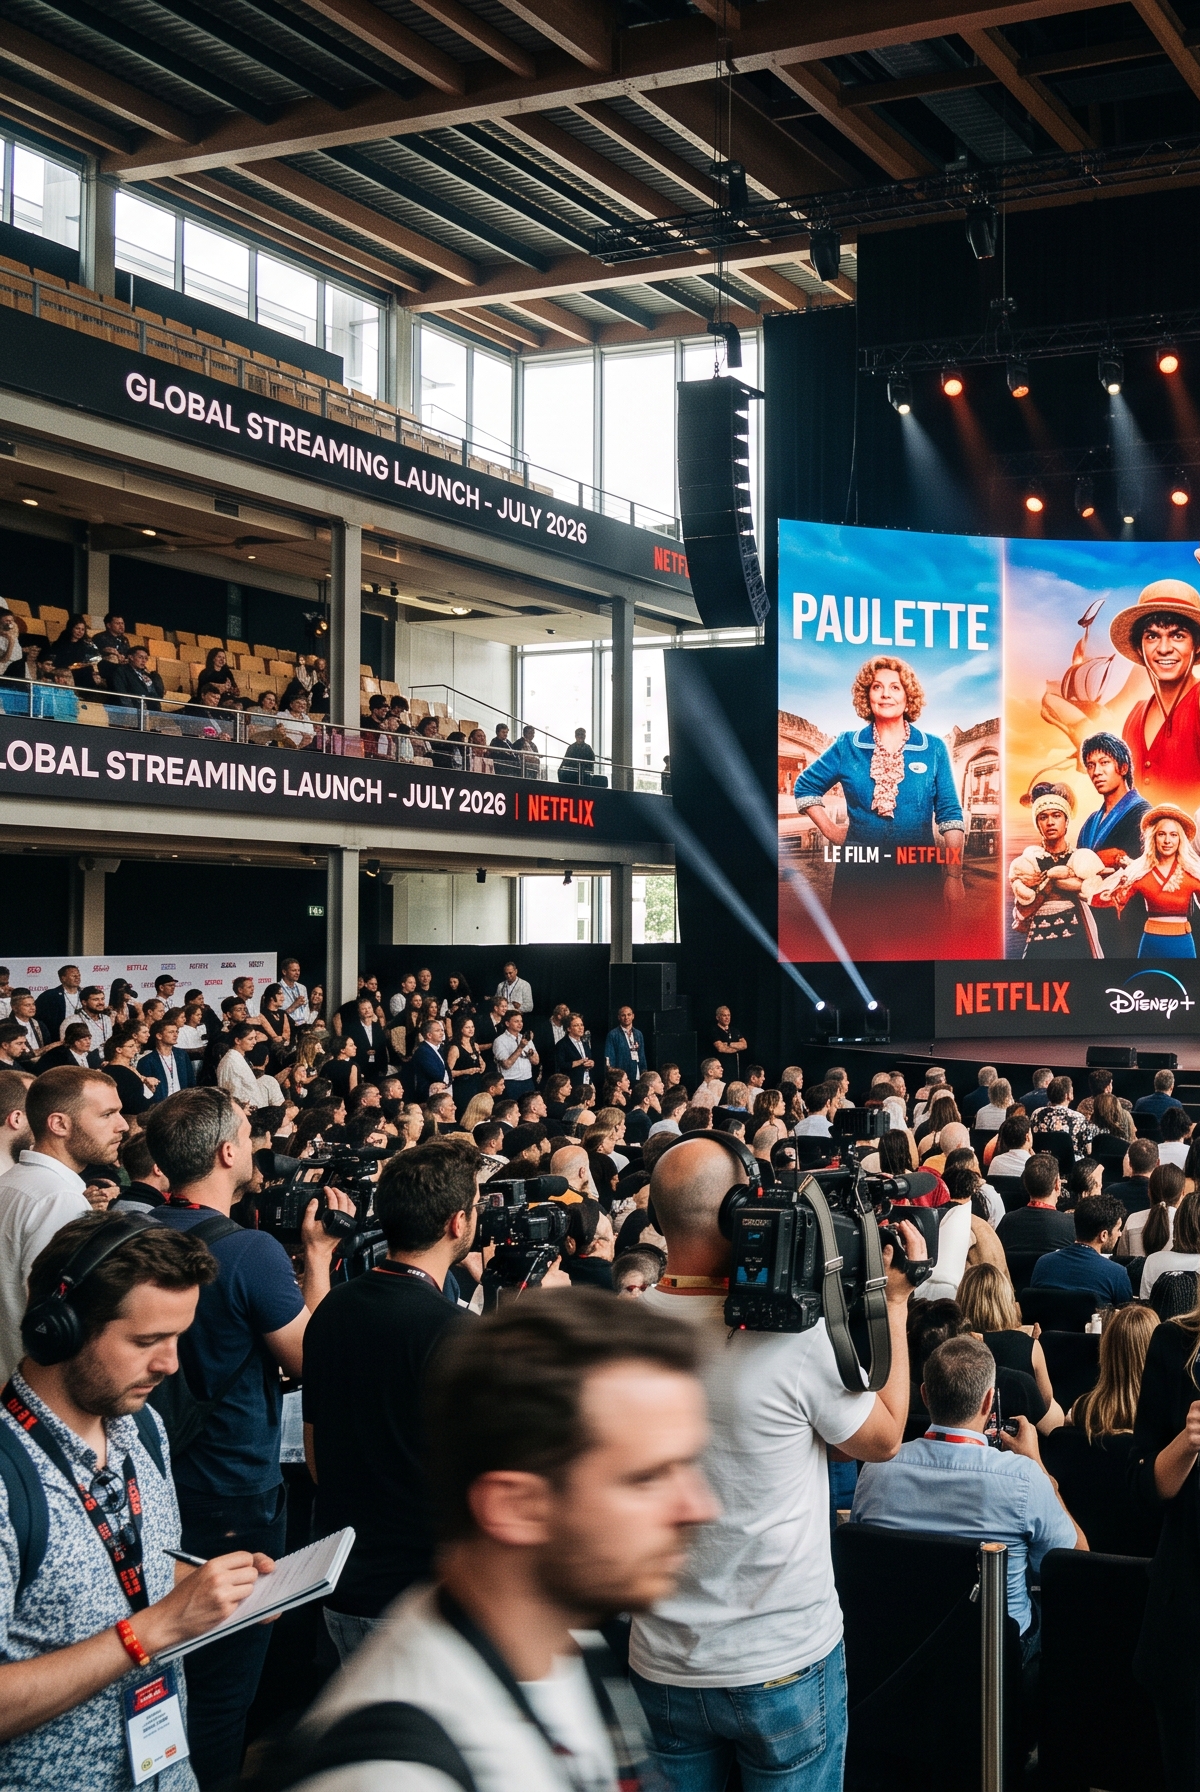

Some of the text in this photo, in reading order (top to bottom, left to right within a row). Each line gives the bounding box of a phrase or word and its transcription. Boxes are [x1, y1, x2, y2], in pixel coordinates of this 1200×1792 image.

[126, 372, 240, 434] GLOBAL
[246, 412, 389, 480] STREAMING
[394, 460, 480, 511] LAUNCH
[497, 497, 542, 529] JULY
[546, 512, 587, 544] 2026
[654, 546, 690, 579] NETFL
[792, 592, 989, 651] PAULETTE
[0, 740, 99, 778] OBAL
[106, 750, 277, 794] STREAMING
[283, 769, 382, 804] LAUNCH
[402, 783, 455, 810] JULY
[459, 788, 506, 816] 2026
[528, 794, 594, 827] NETFLIX
[823, 845, 841, 863] LE
[845, 845, 879, 863] FILM
[896, 846, 961, 866] NETFLIX
[955, 981, 1071, 1016] NETFLIX
